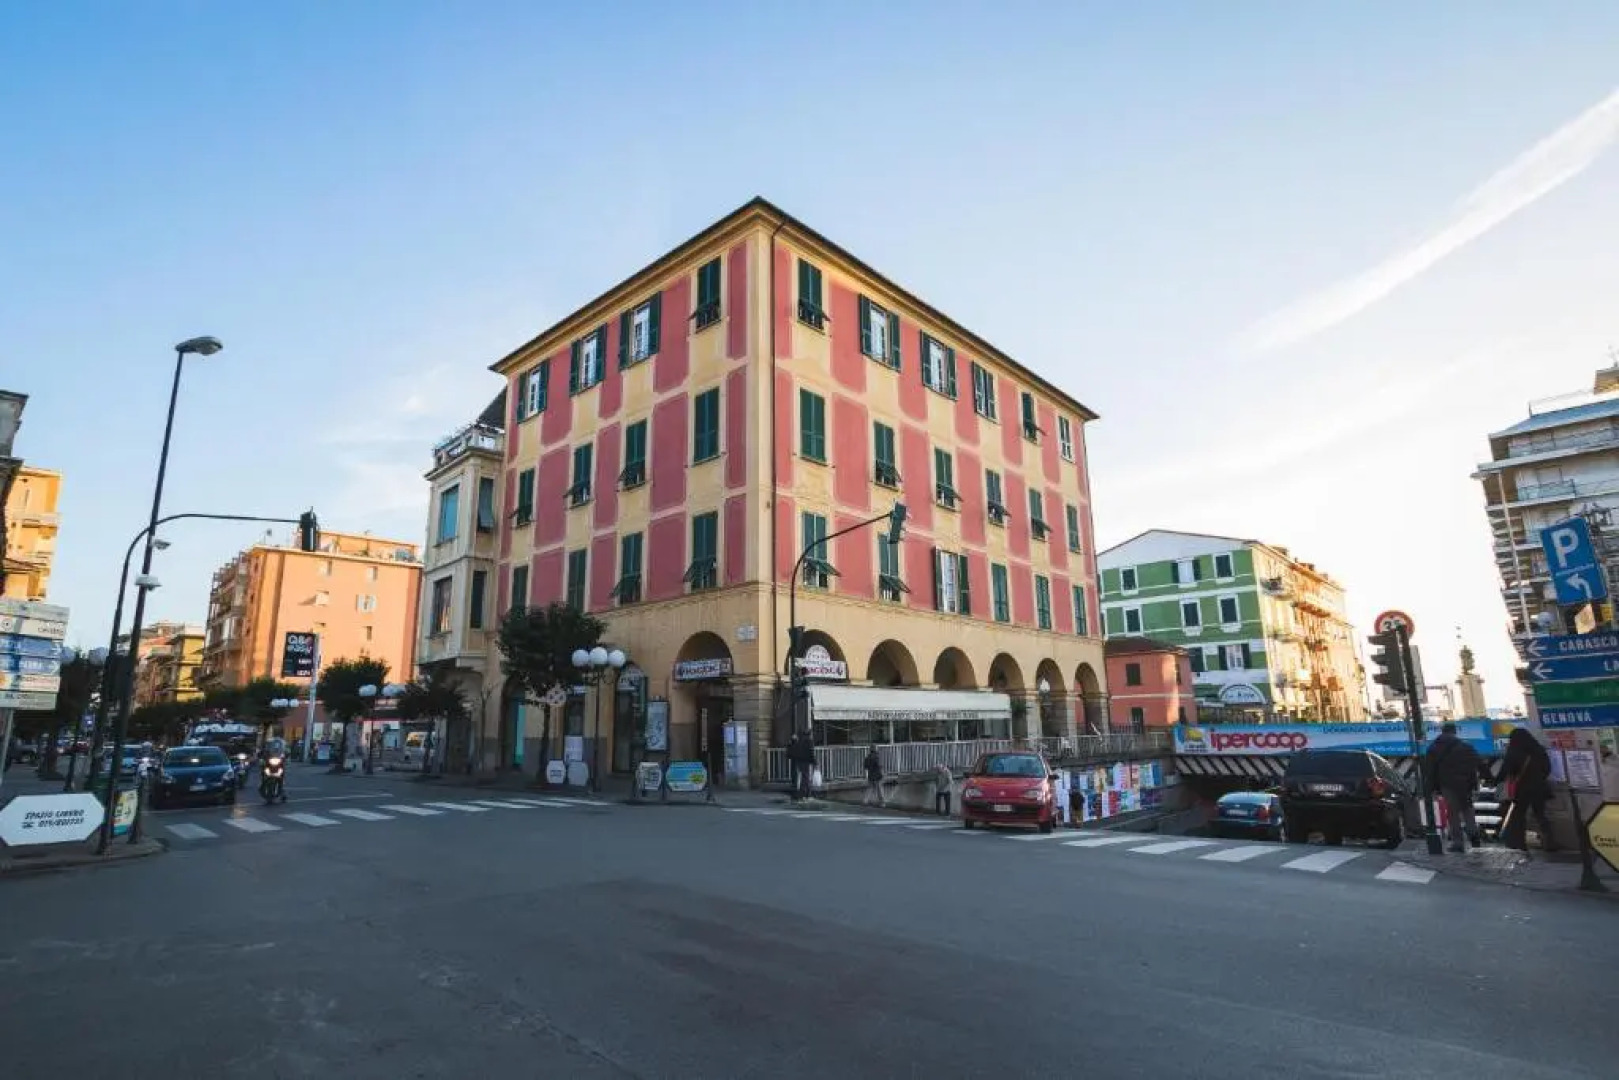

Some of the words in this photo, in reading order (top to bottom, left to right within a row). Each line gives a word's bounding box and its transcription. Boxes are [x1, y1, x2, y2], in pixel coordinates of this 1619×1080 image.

[1551, 528, 1579, 568] P
[1559, 635, 1619, 651] CARASCO
[1542, 711, 1592, 724] GENOVA
[1210, 728, 1309, 752] ipercoop
